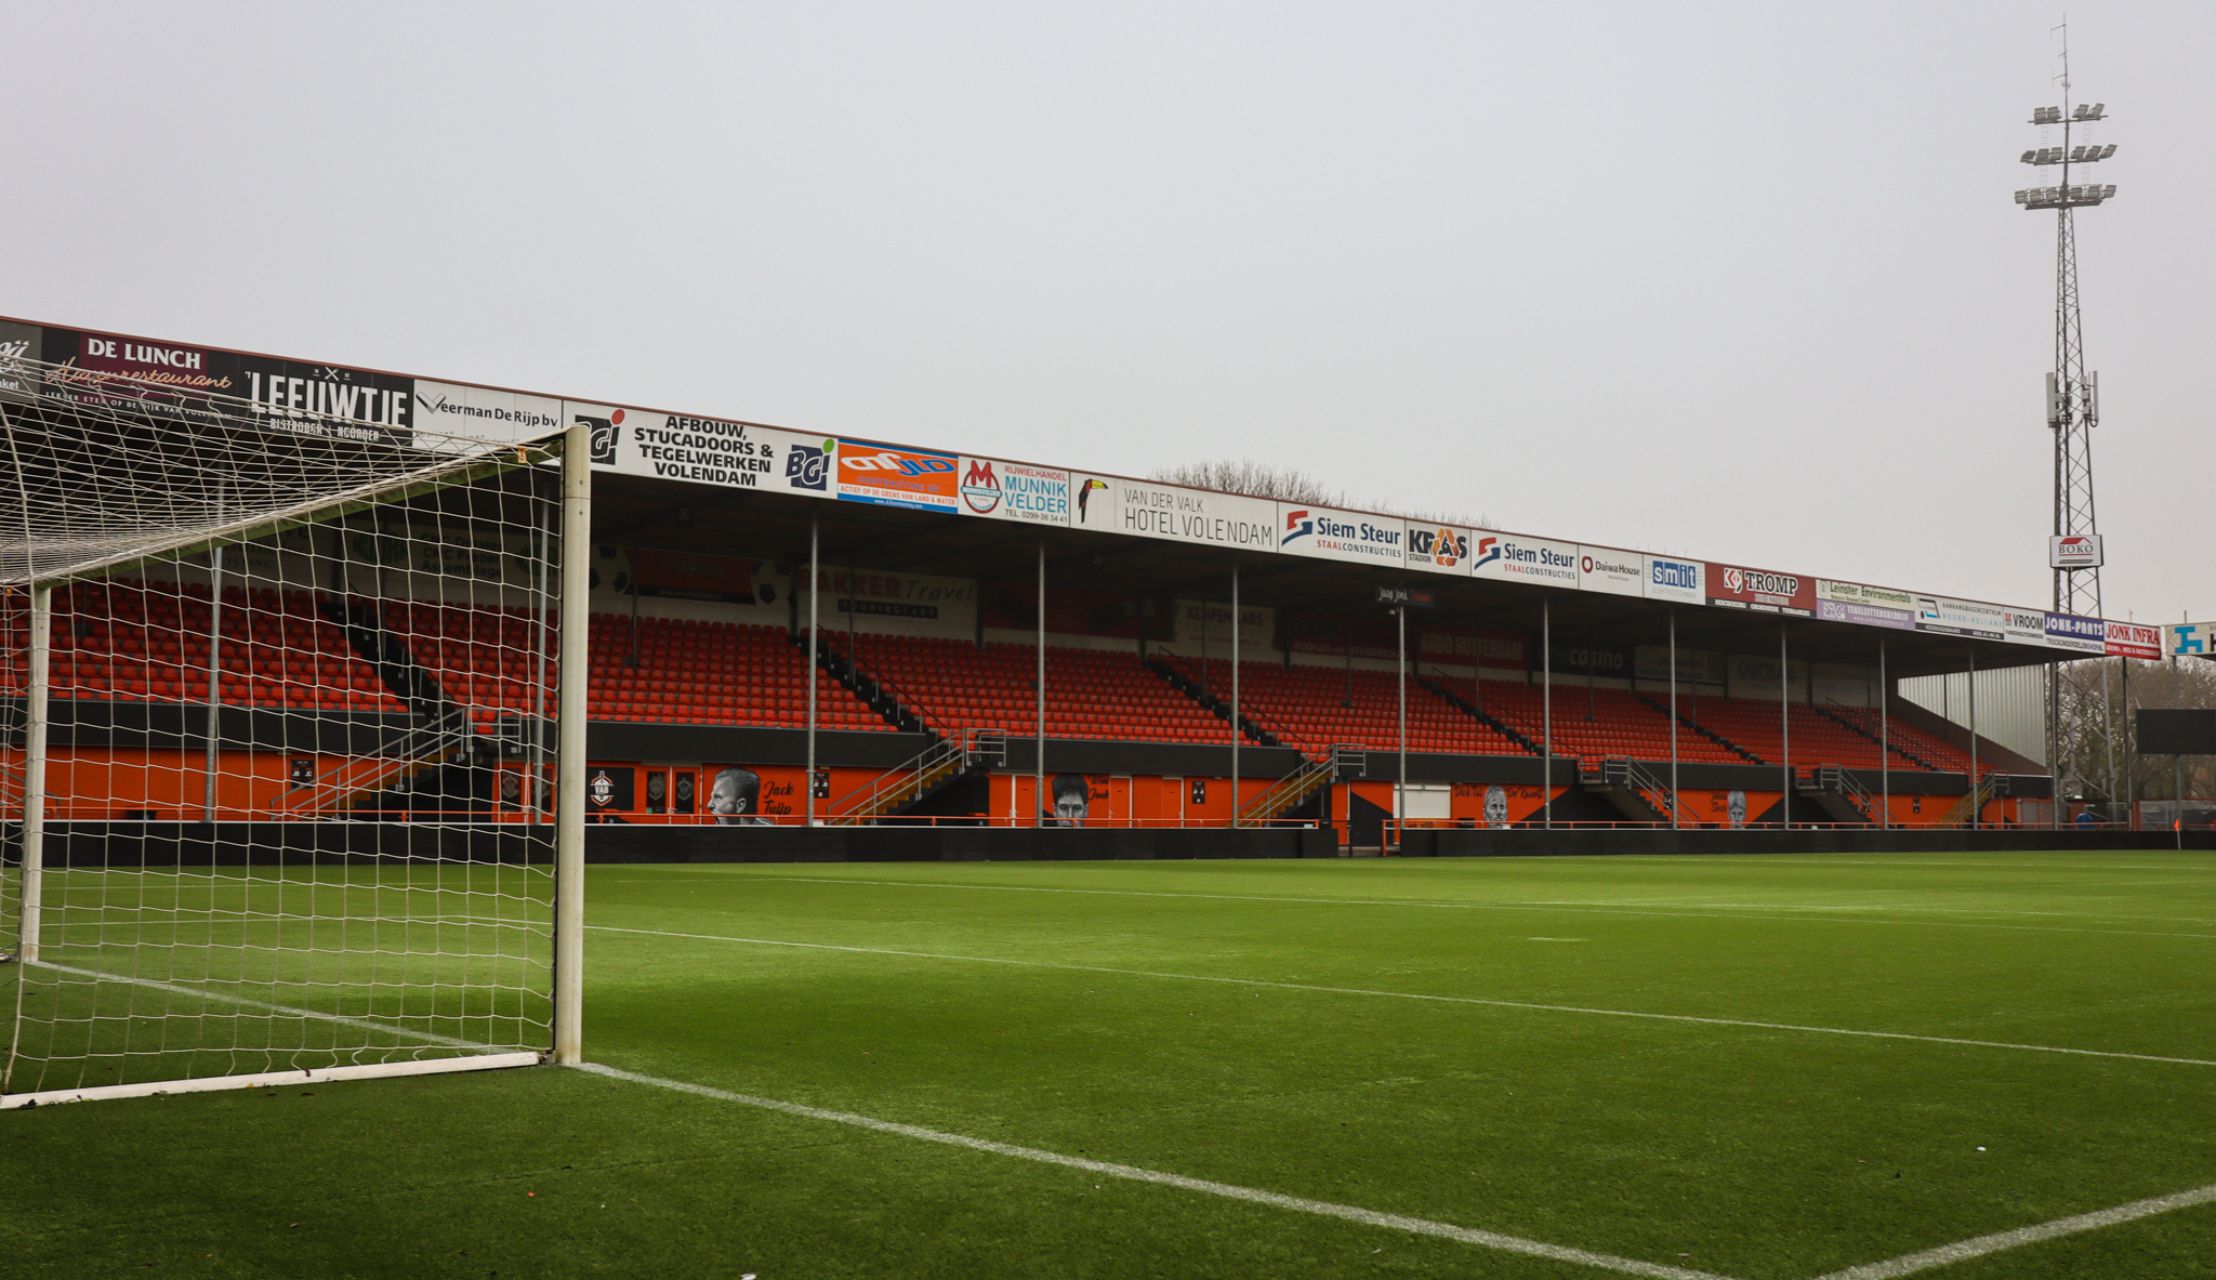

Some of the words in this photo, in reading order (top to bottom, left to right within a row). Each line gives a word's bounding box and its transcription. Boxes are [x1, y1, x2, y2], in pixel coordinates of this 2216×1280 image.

[88, 338, 117, 358] DE
[125, 343, 201, 370] LUNCH
[111, 399, 122, 408] OP
[126, 401, 137, 409] DE
[416, 391, 492, 419] Veerman
[494, 408, 513, 422] De
[514, 410, 540, 428] Rijp
[541, 413, 558, 427] bv
[665, 415, 748, 441] AFBOUW,
[633, 427, 755, 455] STUCADOORS
[760, 444, 774, 458] &
[638, 444, 771, 474] TEGELWERKEN
[654, 462, 756, 487] VOLENDAM
[1004, 464, 1067, 482] RIJWIELHANDEL
[1004, 475, 1067, 497] MUNNIK
[1005, 491, 1067, 514] VELDER
[1124, 488, 1148, 505] VAN
[1151, 491, 1174, 508] DER
[1177, 495, 1204, 513] VALK
[1005, 508, 1019, 518] TEL.
[1051, 514, 1059, 522] 34
[1060, 515, 1067, 523] 41
[1124, 507, 1177, 534] HOTEL
[1181, 515, 1273, 548] VOLENDAM
[1317, 517, 1355, 539] Siem
[1360, 523, 1400, 545] Steur
[1317, 539, 1402, 558] STAALCONSTRUCTIES
[1504, 543, 1536, 563] Siem
[1540, 548, 1575, 568] Steur
[2058, 544, 2094, 554] BOKO
[1504, 563, 1576, 580] STAALCONSTRUCTIES
[1595, 560, 1618, 574] Daiwa
[1619, 563, 1641, 577] House
[1653, 564, 1696, 588] smit
[799, 569, 901, 598] BAKKER
[905, 579, 976, 601] Travel
[1746, 572, 1797, 594] TROMP
[2013, 614, 2043, 630] VROOM
[2106, 623, 2131, 641] JONK
[2133, 628, 2160, 645] INFRA
